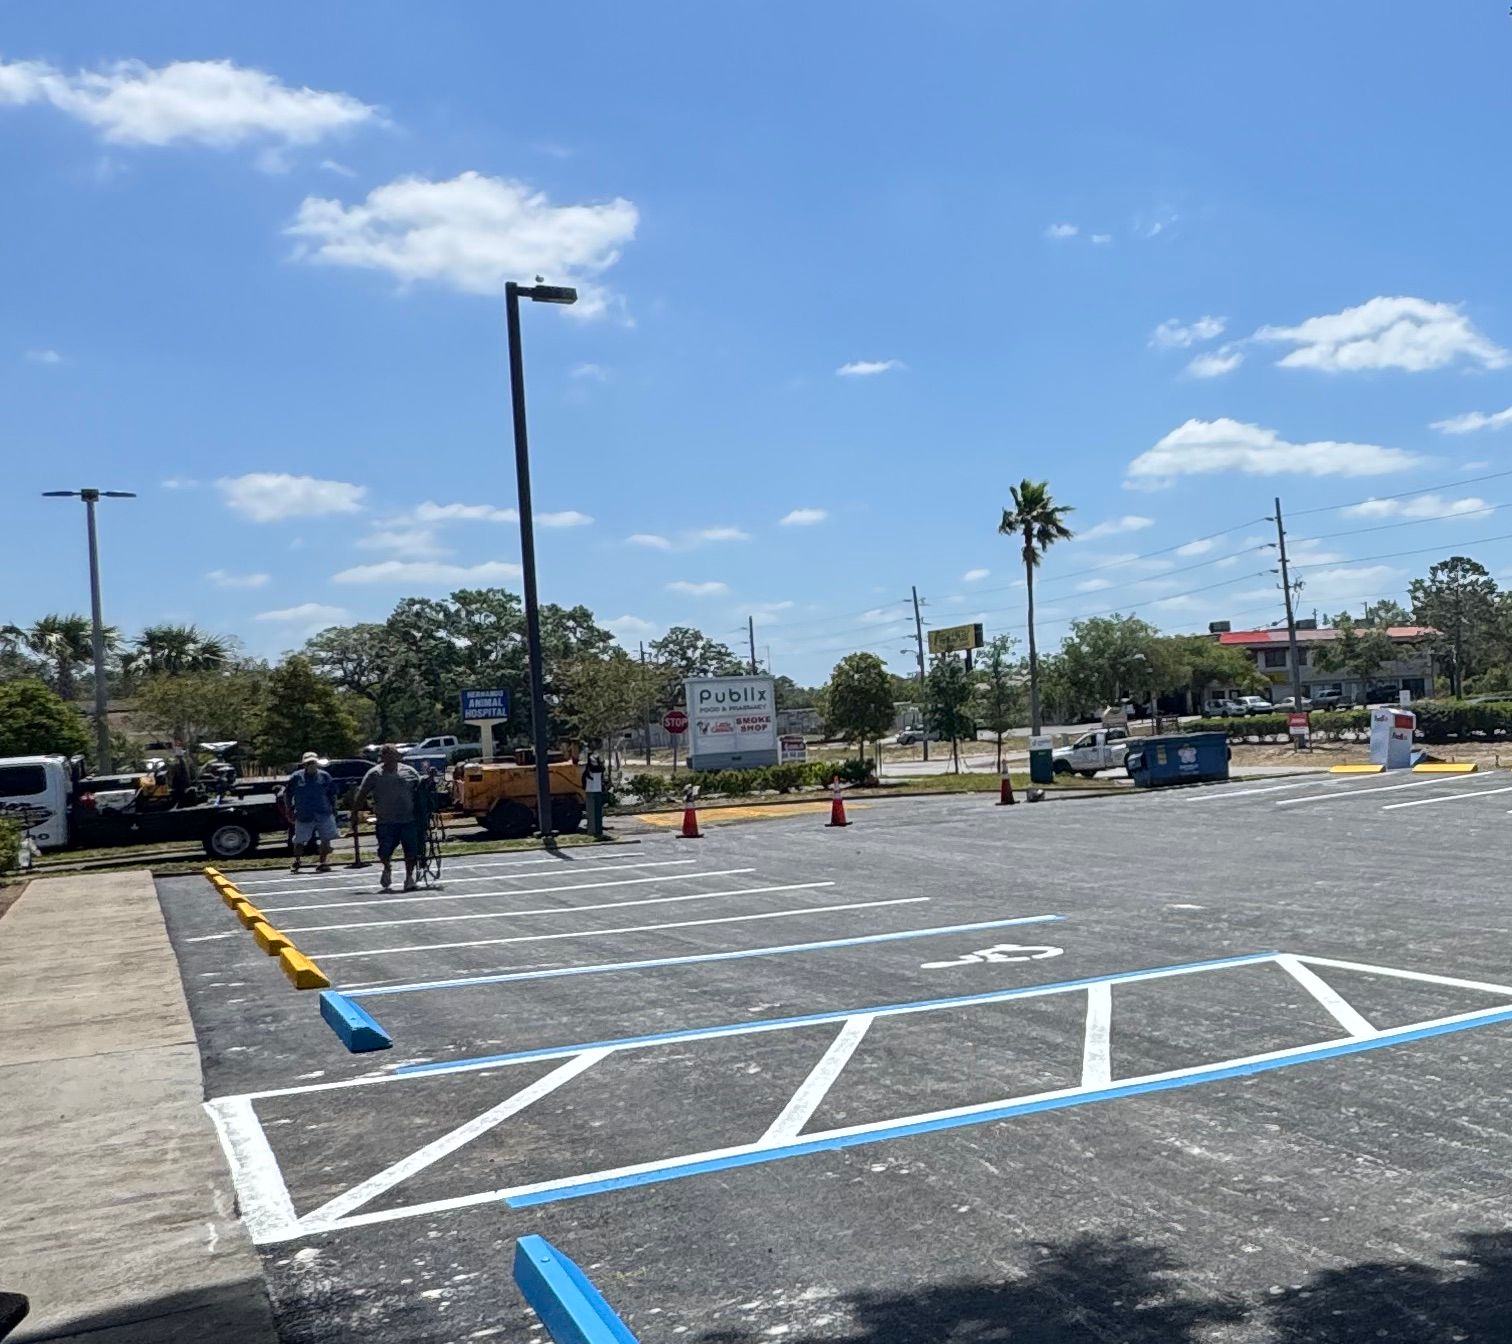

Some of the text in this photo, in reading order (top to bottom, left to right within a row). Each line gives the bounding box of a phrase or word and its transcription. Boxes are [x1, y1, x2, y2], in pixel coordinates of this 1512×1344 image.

[699, 687, 766, 704] Publix
[468, 698, 503, 708] ANIMAL
[465, 707, 507, 718] HOSPITAL
[665, 717, 688, 729] STOP
[736, 716, 771, 725] SMOKE
[741, 724, 768, 732] SHOP
